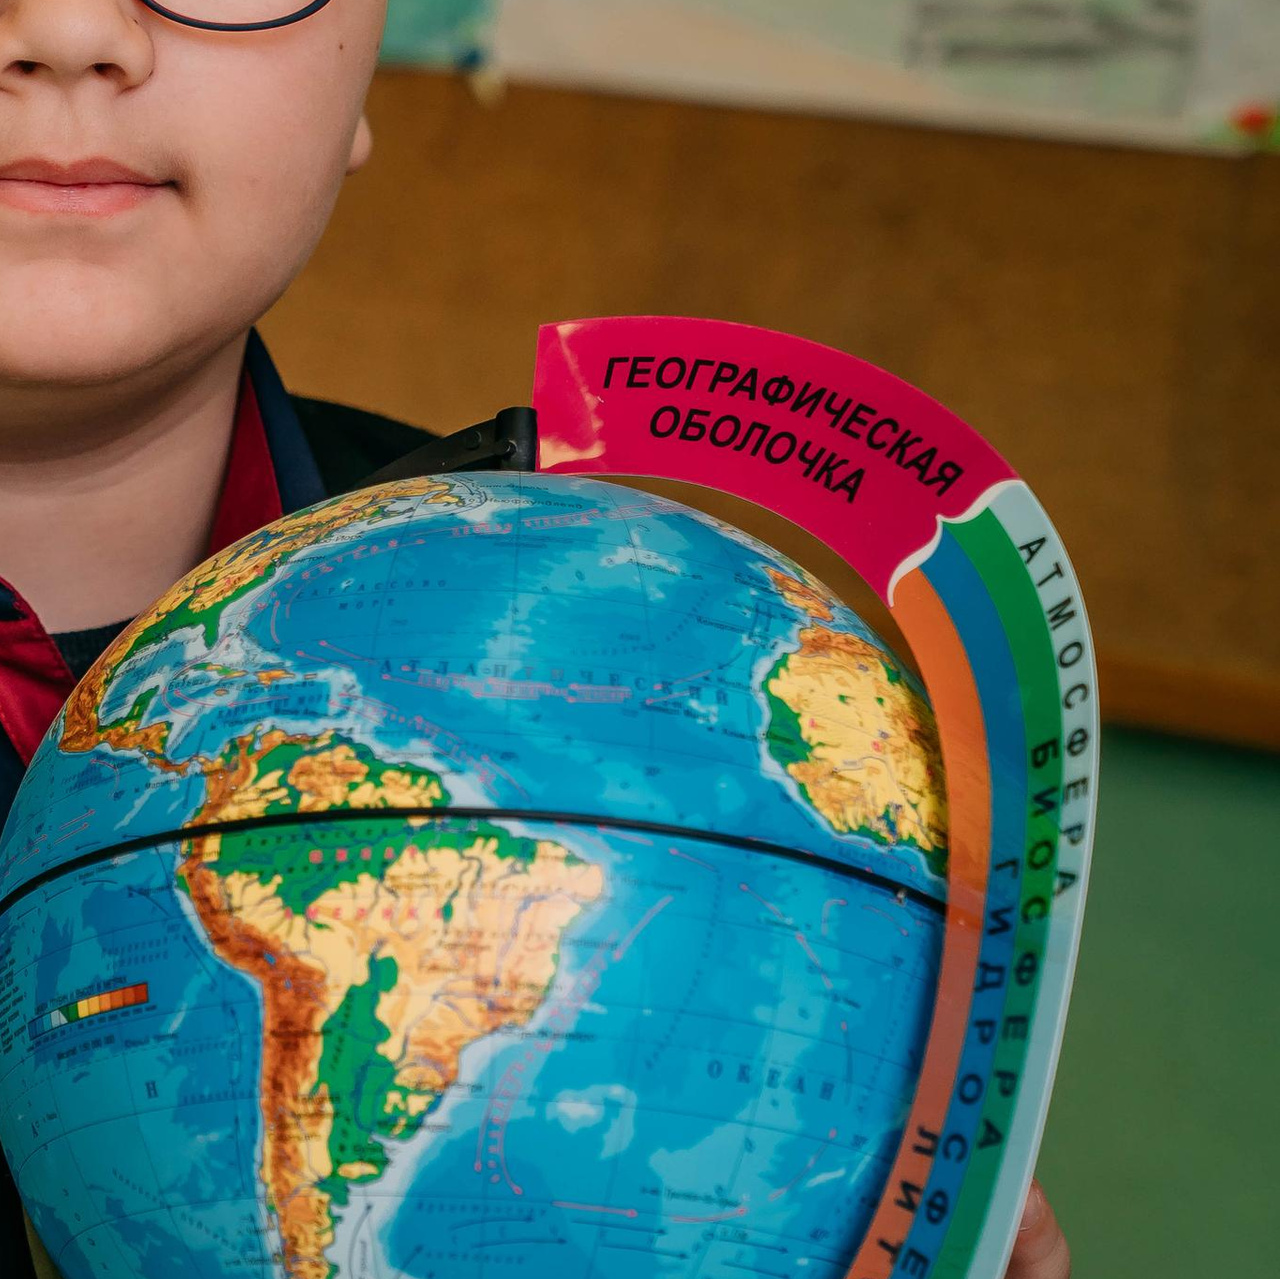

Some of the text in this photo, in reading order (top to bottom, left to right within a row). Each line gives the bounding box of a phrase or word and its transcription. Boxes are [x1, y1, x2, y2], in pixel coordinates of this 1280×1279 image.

[603, 356, 964, 497] ГЕОГРАФИЧЕСКАЯ
[649, 405, 867, 504] ОБОЛОЧКА
[1018, 536, 1090, 899] АТМОСФЕРА
[978, 737, 1060, 1151] БИОСФЕРА
